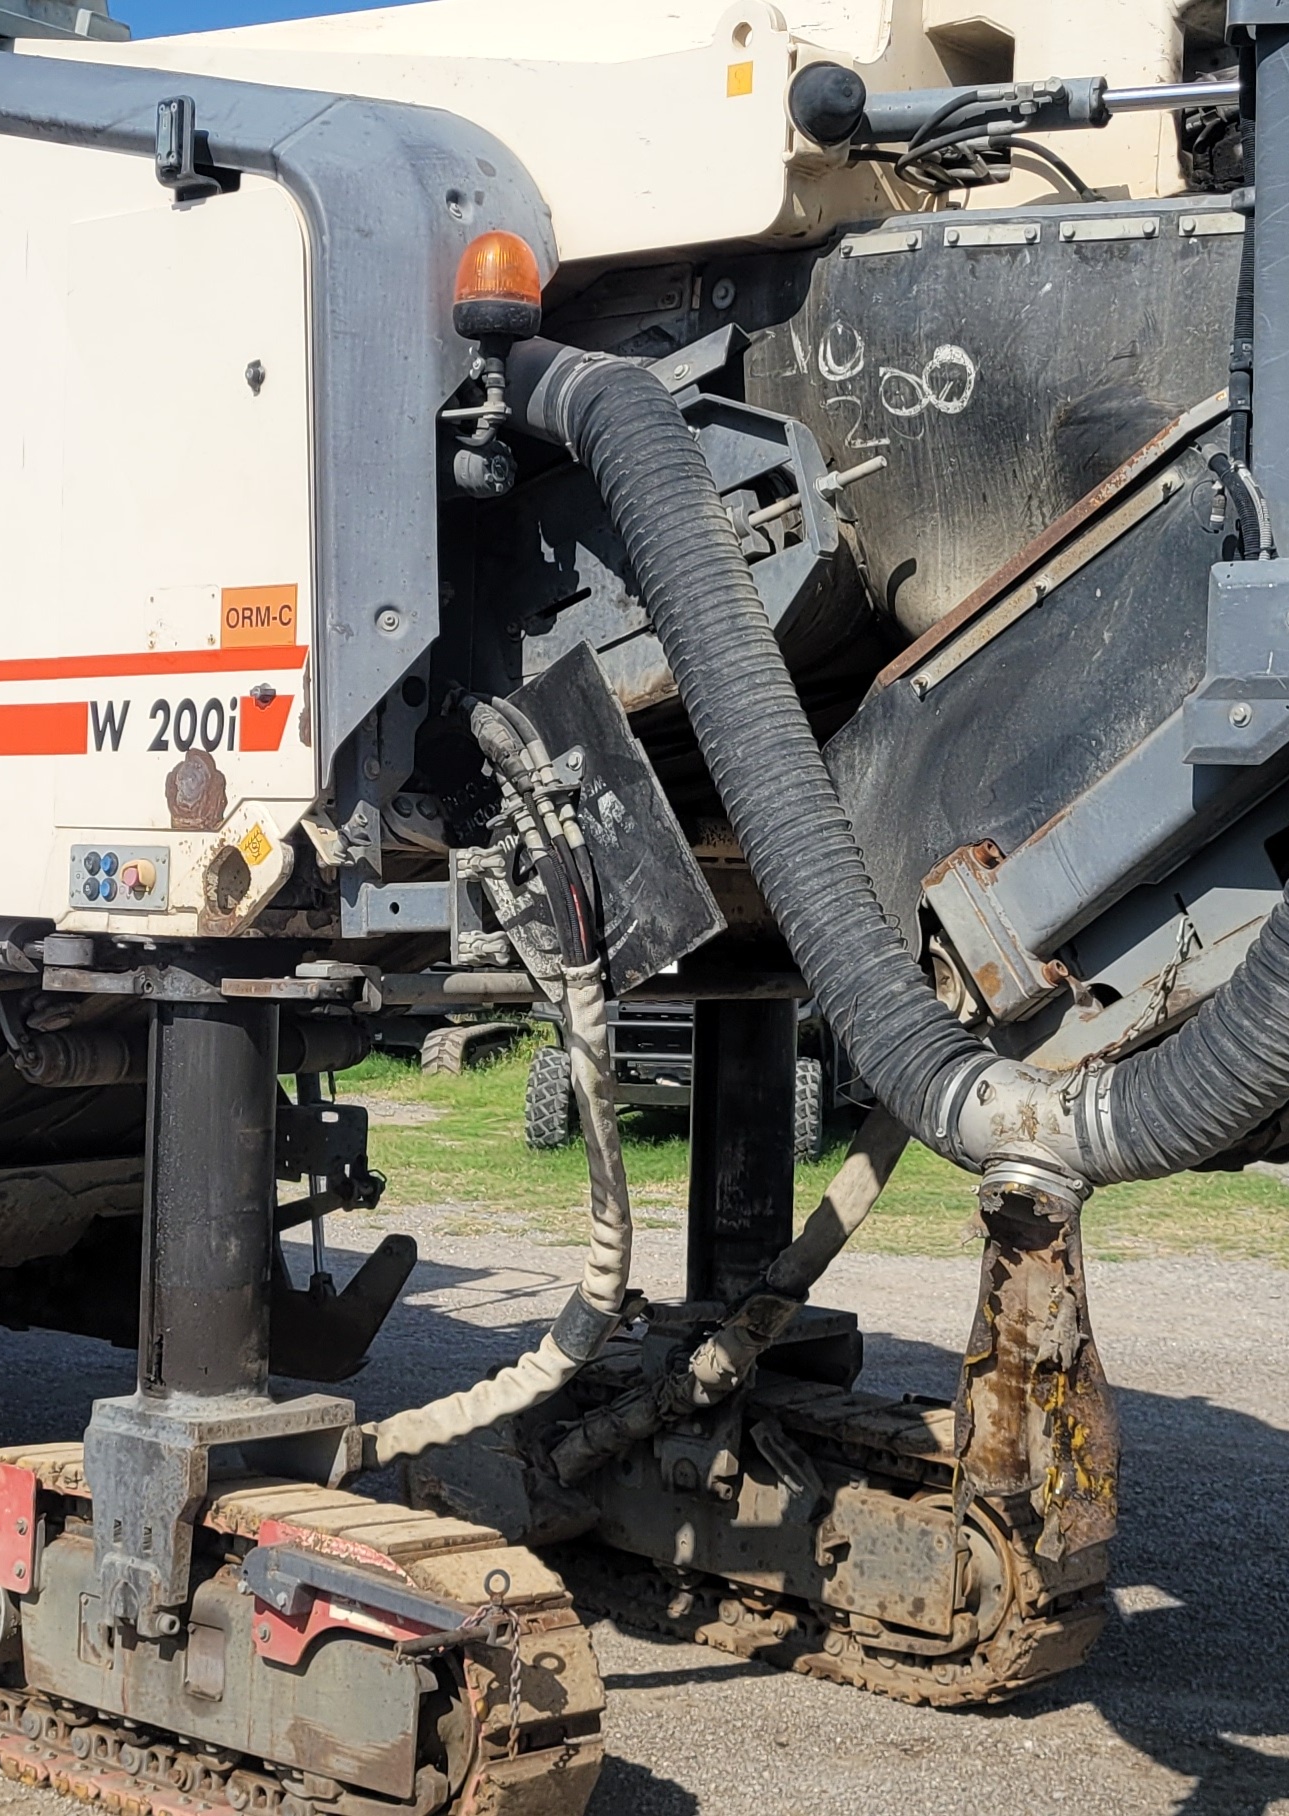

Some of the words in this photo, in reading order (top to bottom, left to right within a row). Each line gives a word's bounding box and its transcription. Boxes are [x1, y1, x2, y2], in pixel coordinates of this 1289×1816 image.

[225, 604, 293, 629] ORM-C
[90, 699, 131, 752] W
[146, 696, 238, 752] 200i
